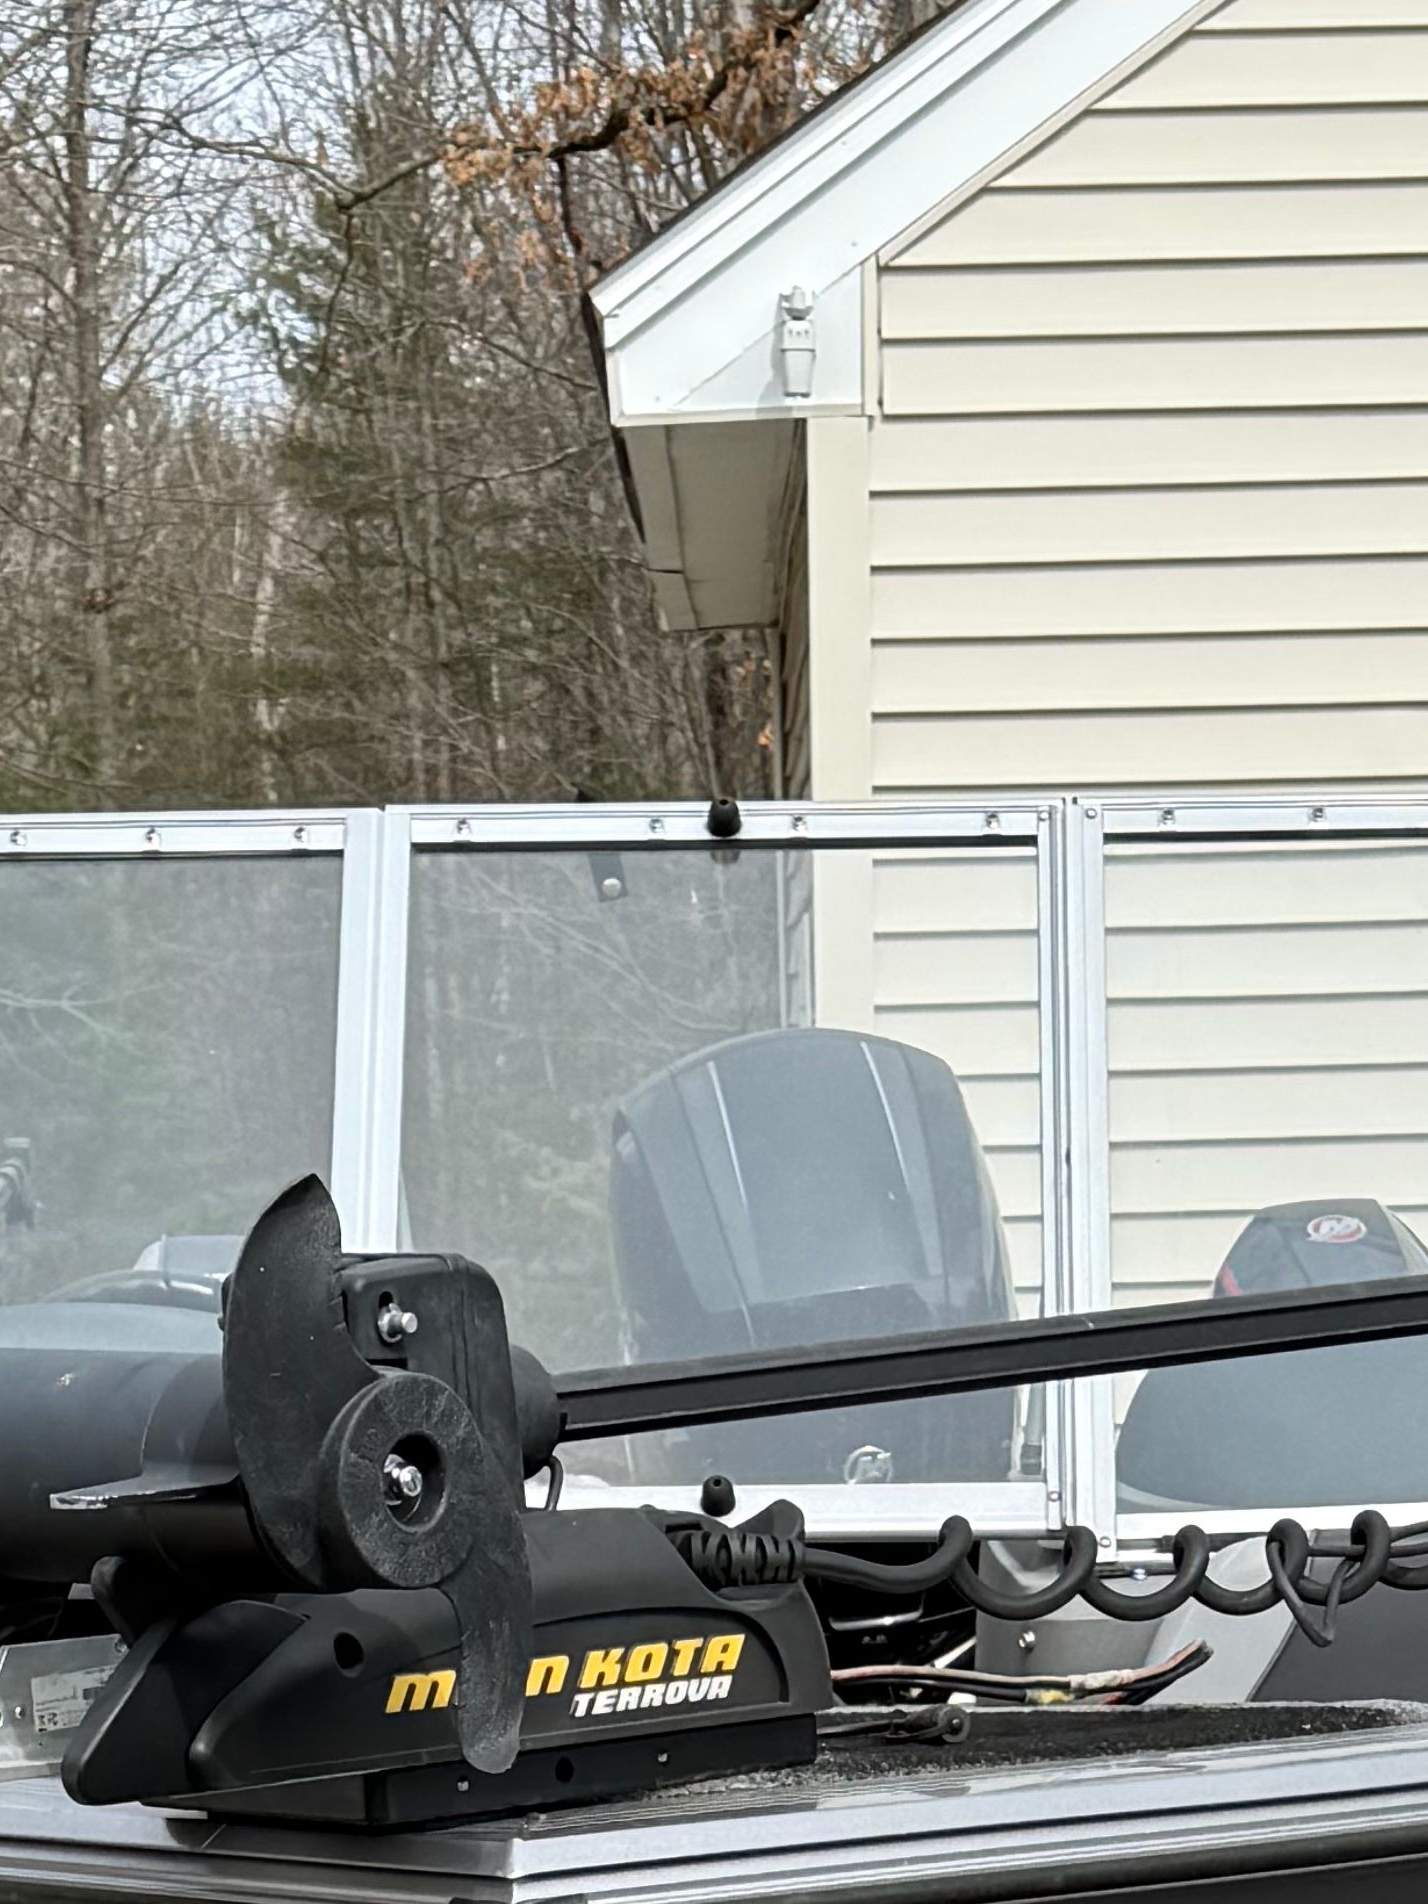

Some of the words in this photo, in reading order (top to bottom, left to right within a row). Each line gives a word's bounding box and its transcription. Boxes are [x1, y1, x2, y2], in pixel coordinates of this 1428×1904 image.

[384, 1655, 570, 1713] MN
[580, 1633, 746, 1688] KOTA
[571, 1675, 734, 1717] TERROVA
